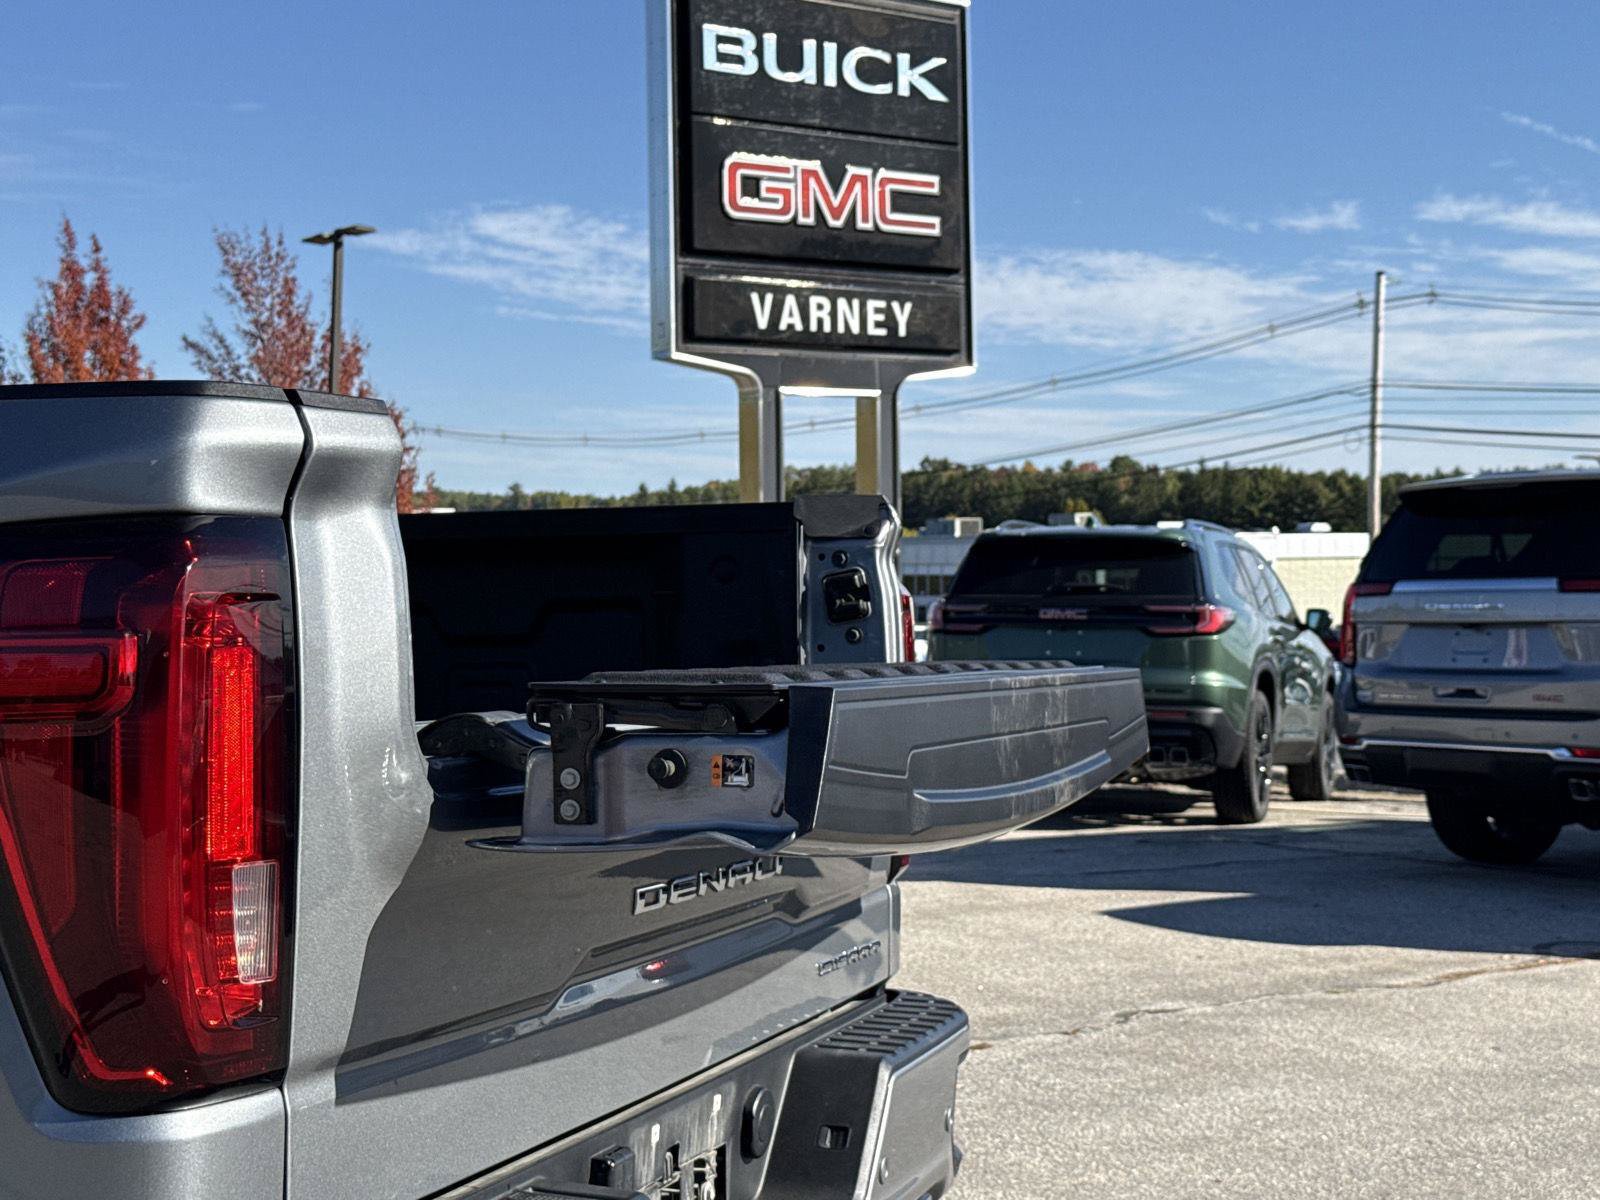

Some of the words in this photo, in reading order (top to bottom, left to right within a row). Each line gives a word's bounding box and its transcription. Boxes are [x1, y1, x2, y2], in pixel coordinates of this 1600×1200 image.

[702, 23, 949, 103] BUICK
[722, 152, 942, 237] GMC
[750, 291, 913, 338] VARNEY
[633, 855, 783, 915] DENALI
